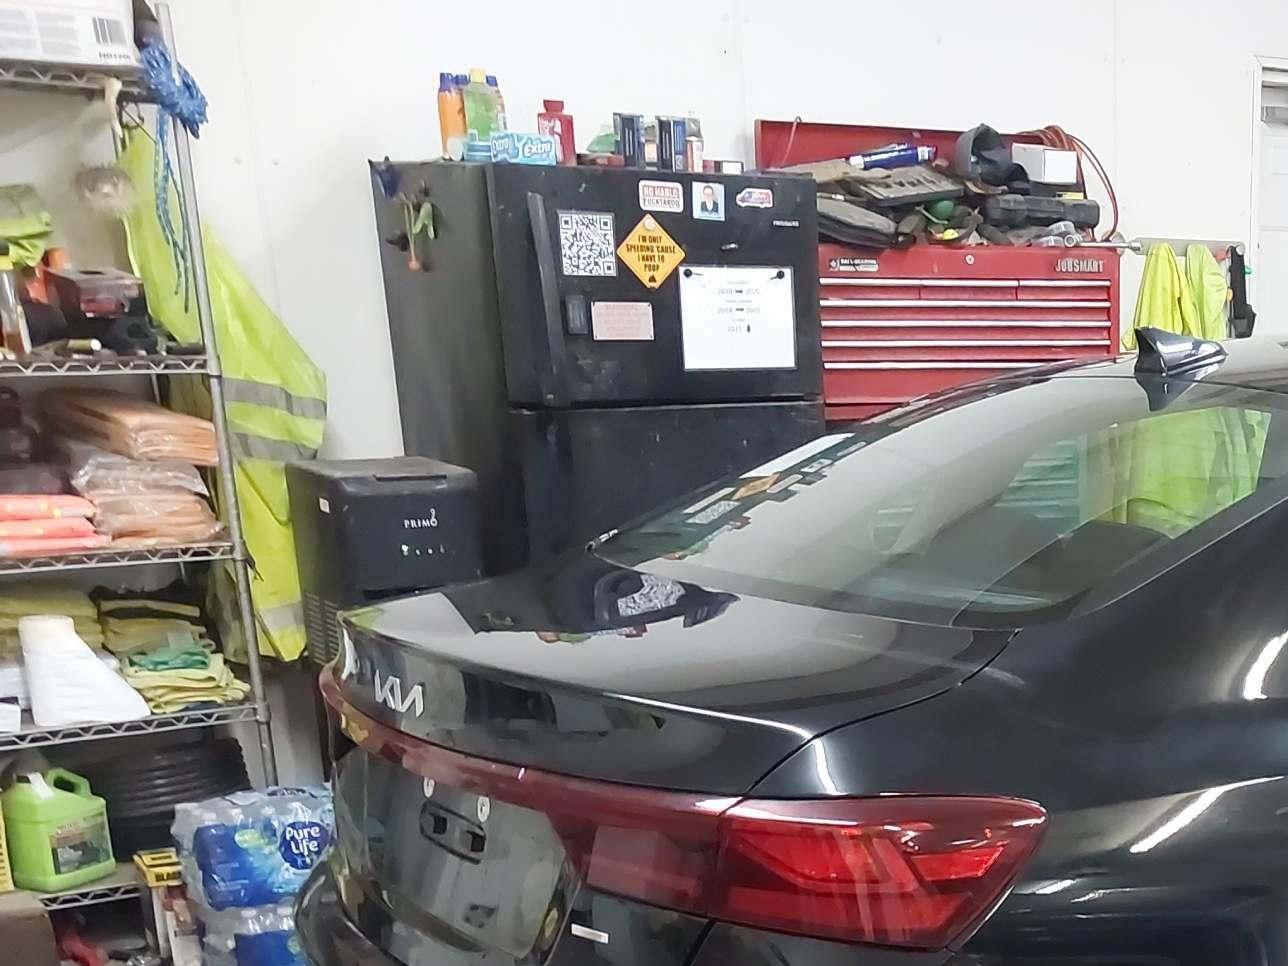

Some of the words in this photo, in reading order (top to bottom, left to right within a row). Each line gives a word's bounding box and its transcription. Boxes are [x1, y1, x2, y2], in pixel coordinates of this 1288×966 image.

[643, 186, 654, 197] NO
[654, 186, 678, 198] HABLO
[648, 235, 662, 244] ONLY
[626, 244, 654, 253] SPEEDING
[641, 255, 656, 263] HAVE
[657, 255, 665, 263] TO
[1055, 258, 1104, 272] JOBSMART
[644, 264, 660, 272] POOP
[374, 669, 424, 718] KIA
[285, 826, 320, 841] Pure
[290, 838, 319, 857] Life
